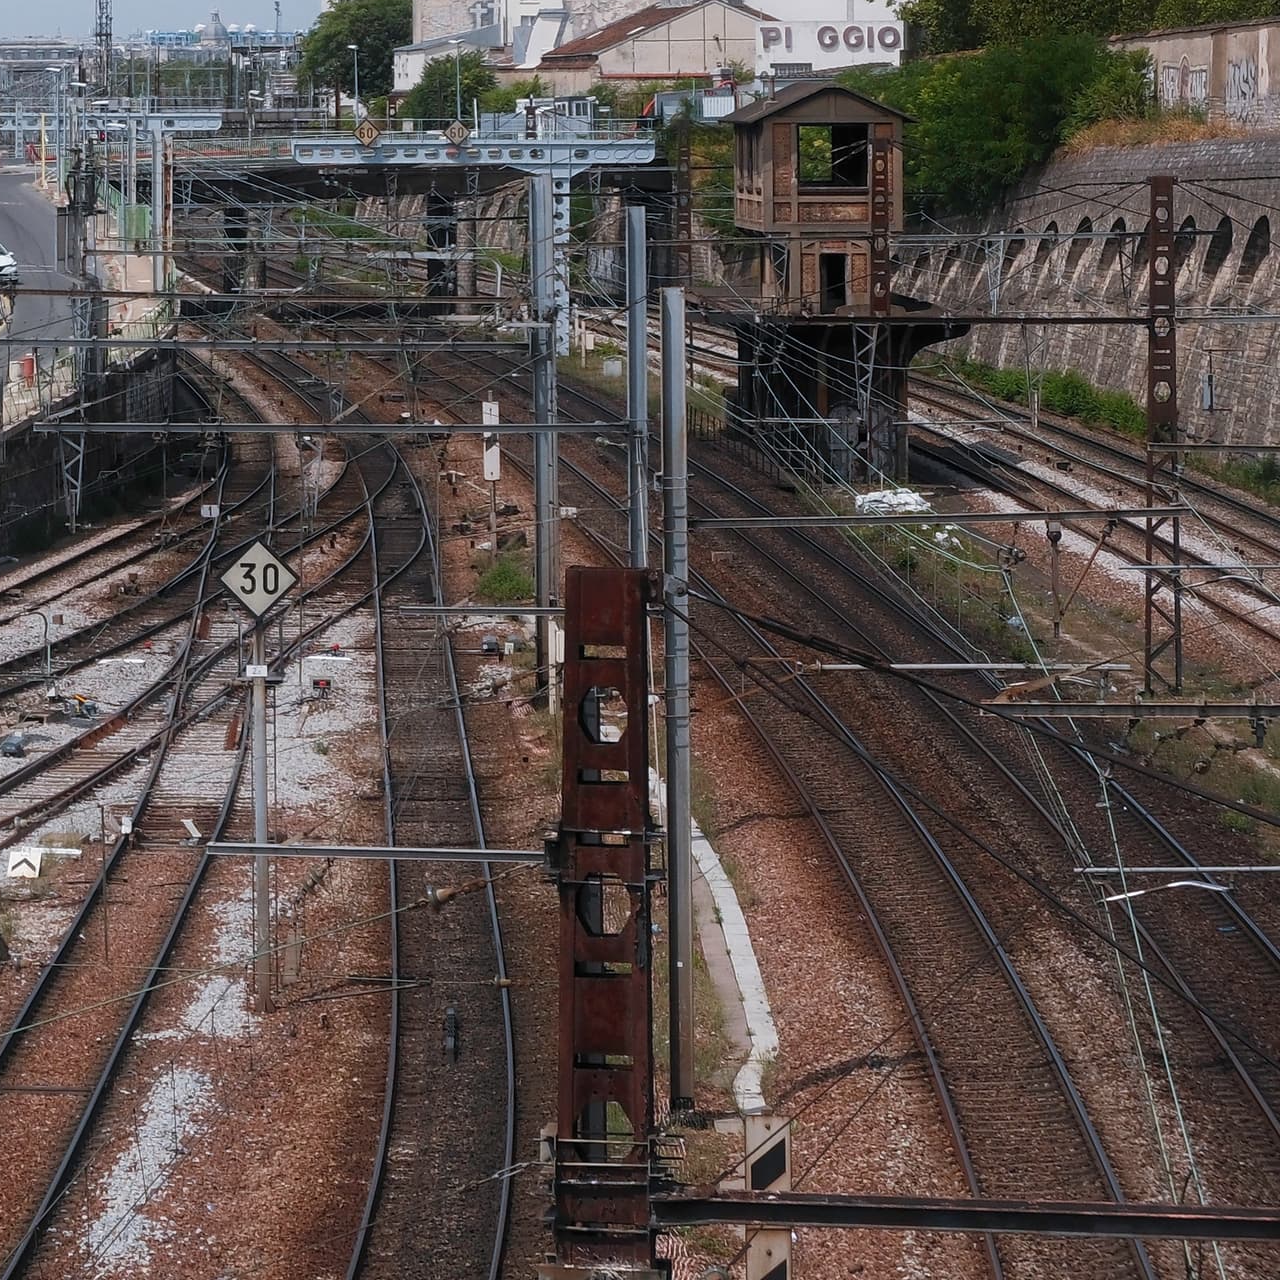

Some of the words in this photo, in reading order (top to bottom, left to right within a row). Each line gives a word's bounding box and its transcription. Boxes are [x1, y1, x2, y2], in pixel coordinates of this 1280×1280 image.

[360, 127, 374, 139] 60
[450, 127, 464, 139] 60
[240, 562, 280, 595] 30
